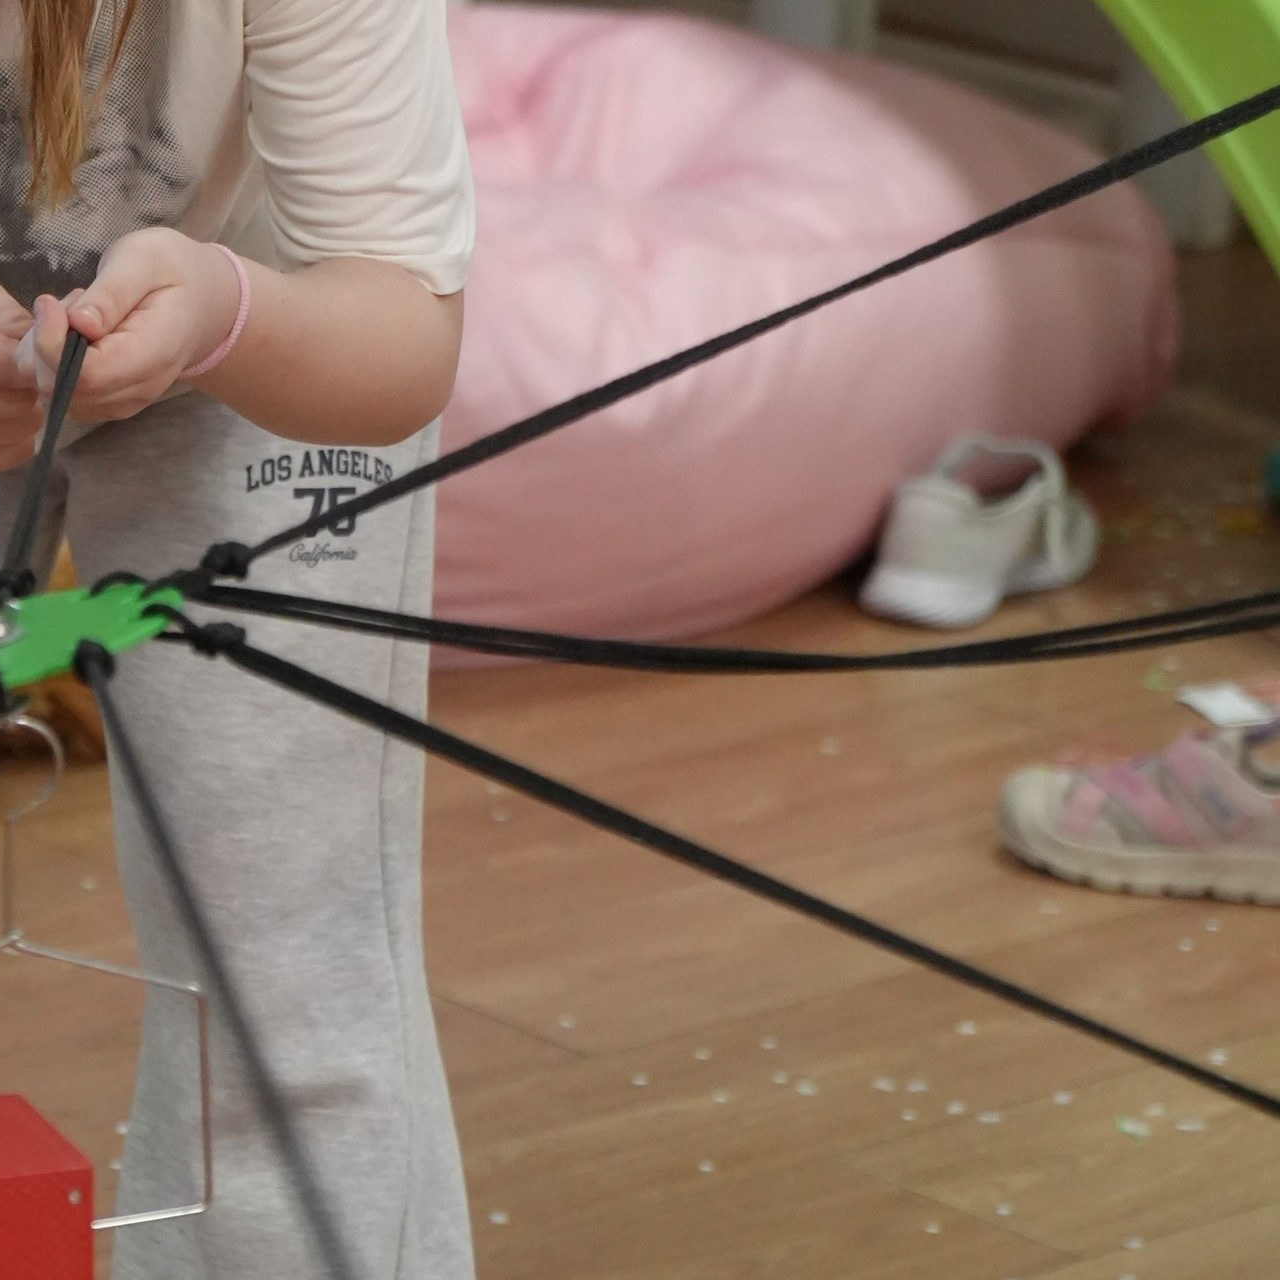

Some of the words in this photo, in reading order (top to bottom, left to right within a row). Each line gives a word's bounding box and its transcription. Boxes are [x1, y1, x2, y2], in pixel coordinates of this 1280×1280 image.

[245, 455, 292, 492] LOS
[298, 449, 394, 486] ANGELES
[289, 543, 357, 568] California
